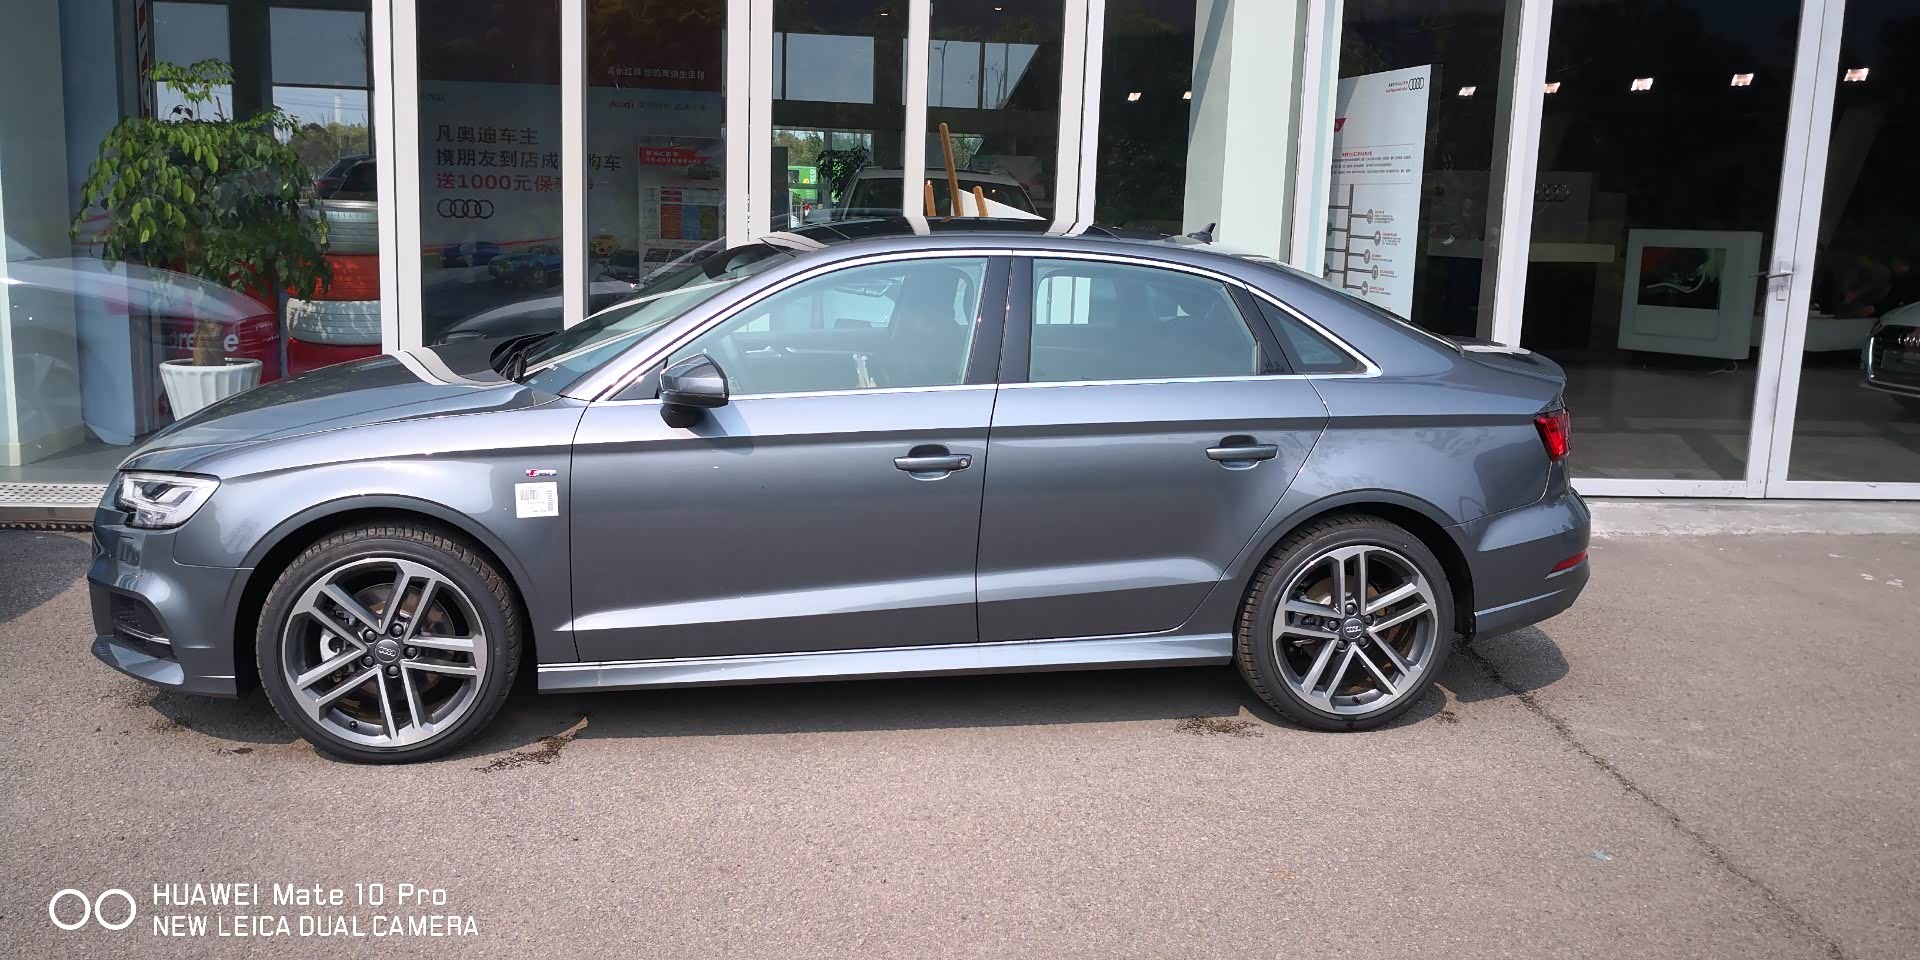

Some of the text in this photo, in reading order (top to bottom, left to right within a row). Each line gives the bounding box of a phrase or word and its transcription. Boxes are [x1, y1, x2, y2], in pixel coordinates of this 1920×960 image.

[436, 124, 538, 145] 凡奥迪车主
[436, 148, 622, 172] 携朋友到店成购车
